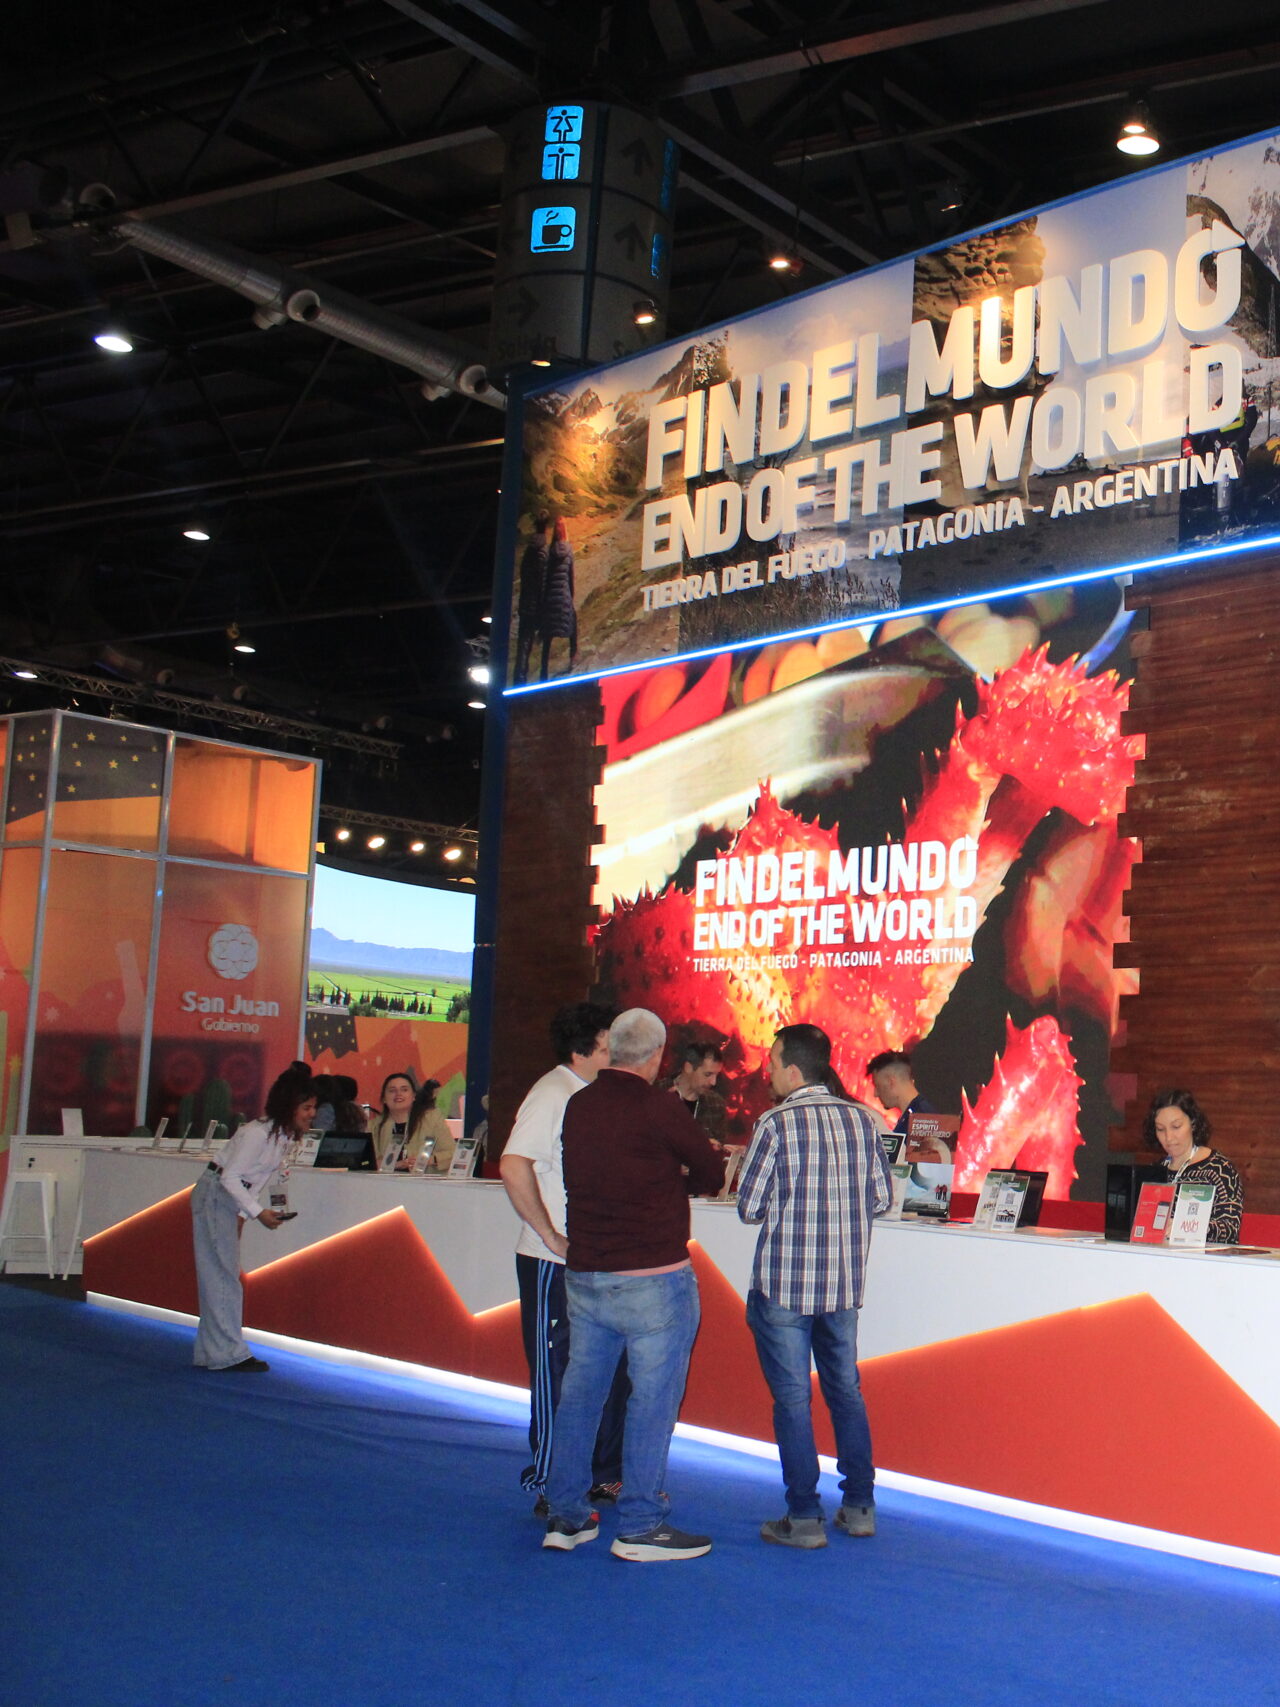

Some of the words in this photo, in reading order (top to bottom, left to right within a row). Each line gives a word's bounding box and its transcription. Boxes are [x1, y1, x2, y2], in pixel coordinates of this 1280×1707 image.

[953, 343, 1243, 490] WORLD
[640, 571, 718, 612] TIERRA
[722, 560, 764, 595] DEL
[768, 539, 846, 583] FUEGO
[868, 497, 1025, 560] PATAGONIA
[1050, 448, 1239, 519] ARGENTINA
[850, 896, 977, 944] WORLD
[693, 957, 733, 972] TIERRA
[736, 956, 757, 971] DEL
[760, 954, 798, 969] FUEGO
[809, 951, 882, 968] PATAGONIA
[894, 947, 974, 965] ARGENTINA
[181, 991, 225, 1013] San
[227, 994, 280, 1017] Juan
[201, 1017, 260, 1033] Gobierno
